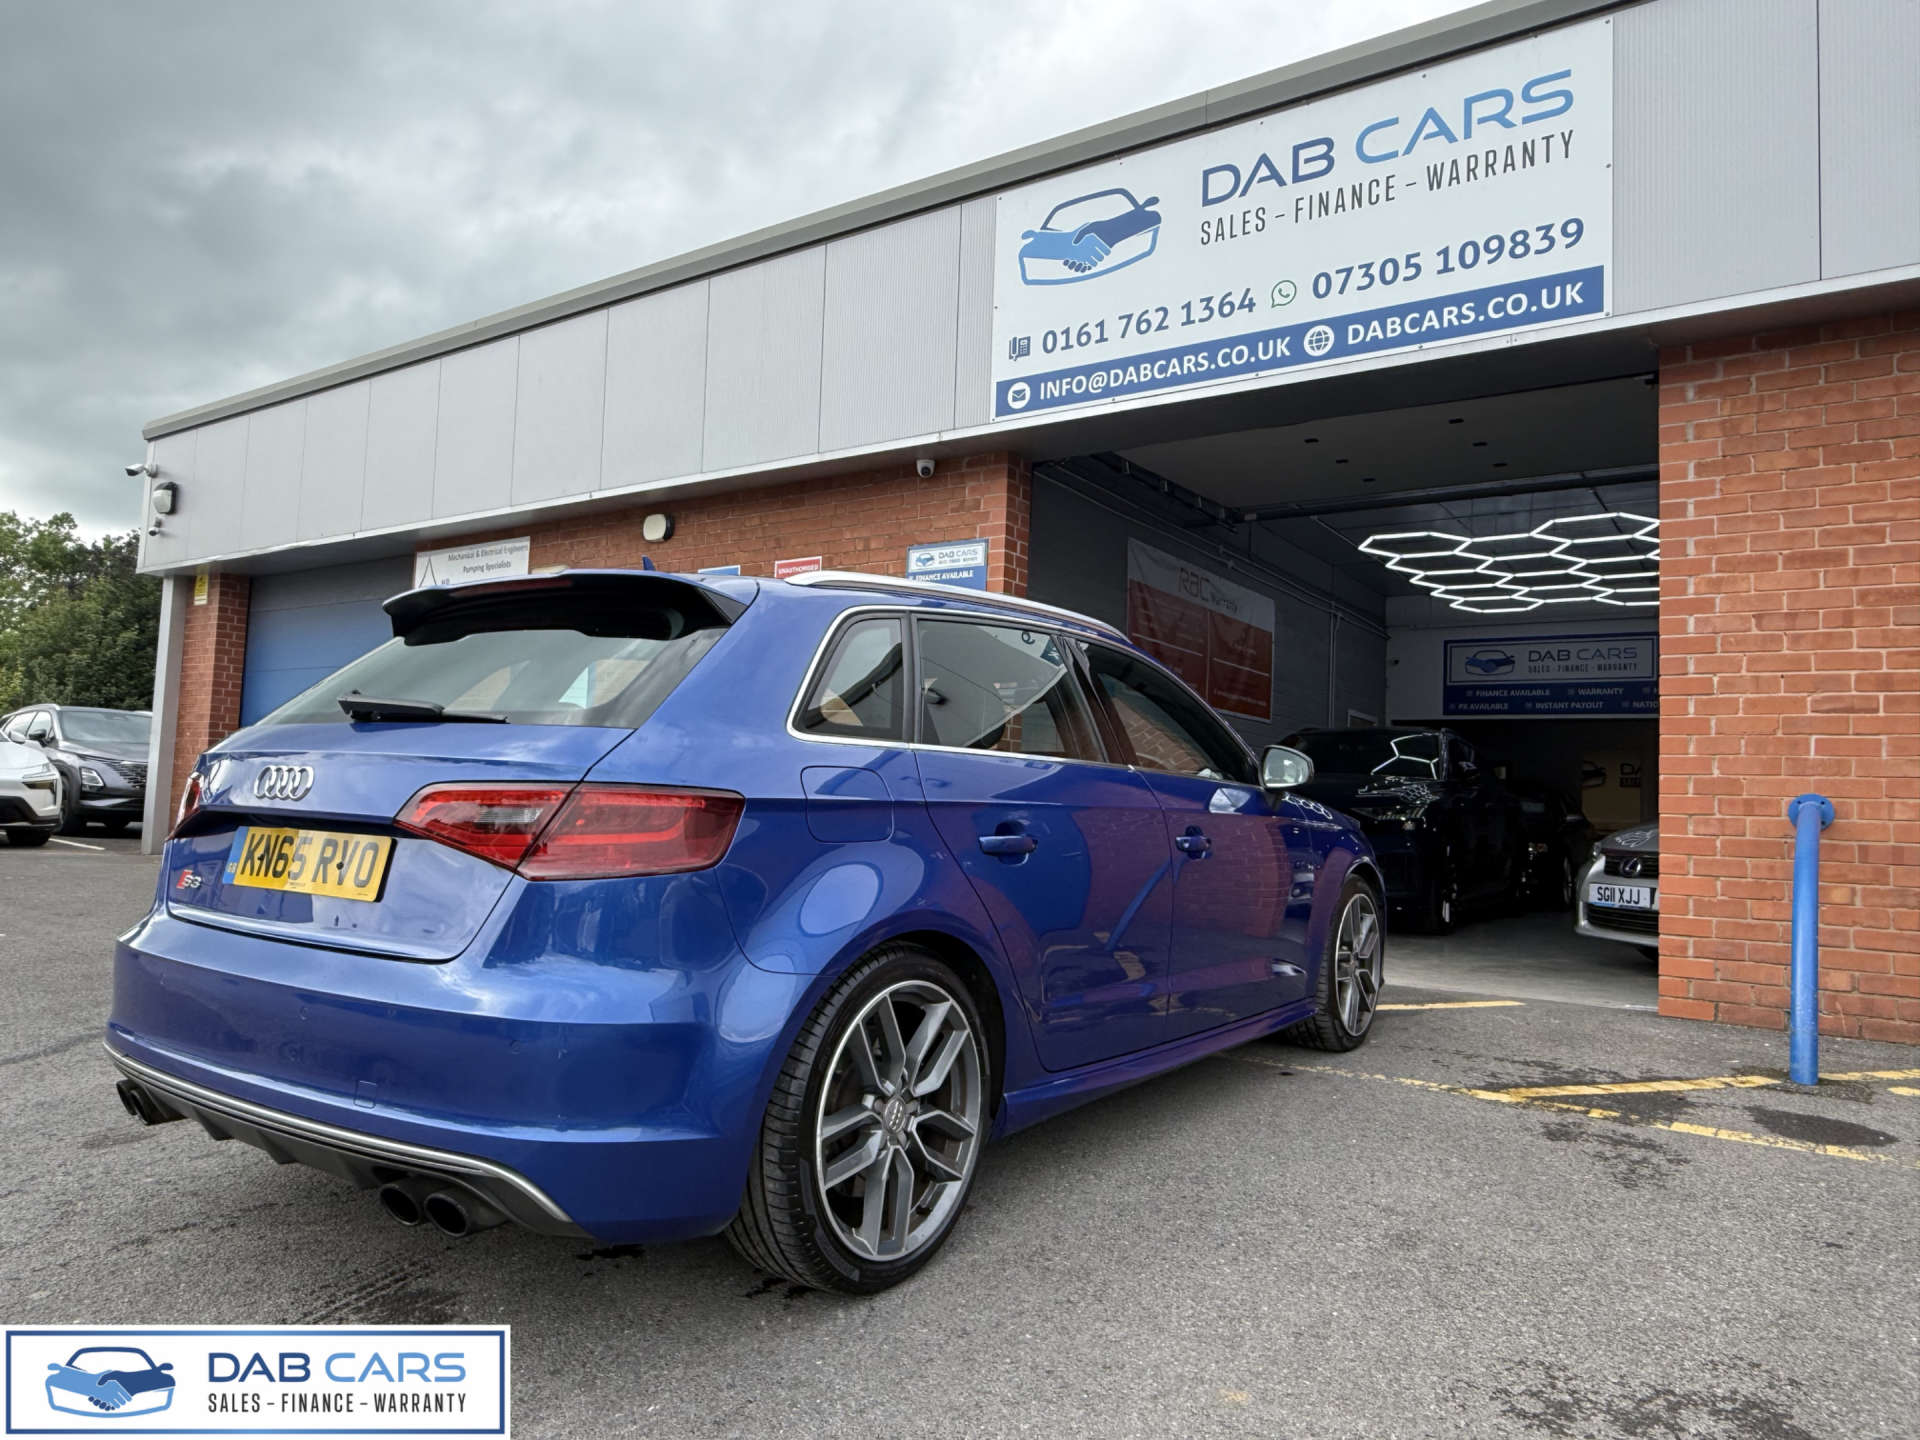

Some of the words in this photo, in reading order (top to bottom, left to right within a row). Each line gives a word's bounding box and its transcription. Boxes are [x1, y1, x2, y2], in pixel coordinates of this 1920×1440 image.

[1201, 136, 1335, 207] DAB
[1355, 69, 1574, 164] CARS
[1200, 206, 1267, 246] SALES
[1294, 173, 1396, 224] FINANCE
[1426, 129, 1574, 192] WARRANTY
[1311, 251, 1422, 300] 07305
[1435, 217, 1585, 276] 109839
[1041, 318, 1109, 354] 0161
[1118, 305, 1170, 336] 762
[1180, 286, 1257, 327] 1364
[1346, 281, 1585, 346] DABCARS.CO.UK
[1039, 335, 1291, 401] INFO@DABCARS.CO.UK
[956, 548, 978, 557] CARS
[1528, 650, 1571, 662] DAB
[1576, 647, 1638, 660] CARS
[1475, 689, 1509, 697] FINANCE
[1510, 688, 1550, 697] AVAILABLE
[1578, 687, 1624, 696] WARRANTY
[1535, 701, 1569, 709] INSTANT
[1570, 701, 1604, 709] PAYOUT
[183, 875, 202, 889] S3
[240, 833, 313, 881] KN65
[312, 838, 380, 888] RVO
[1618, 888, 1641, 904] XJJ
